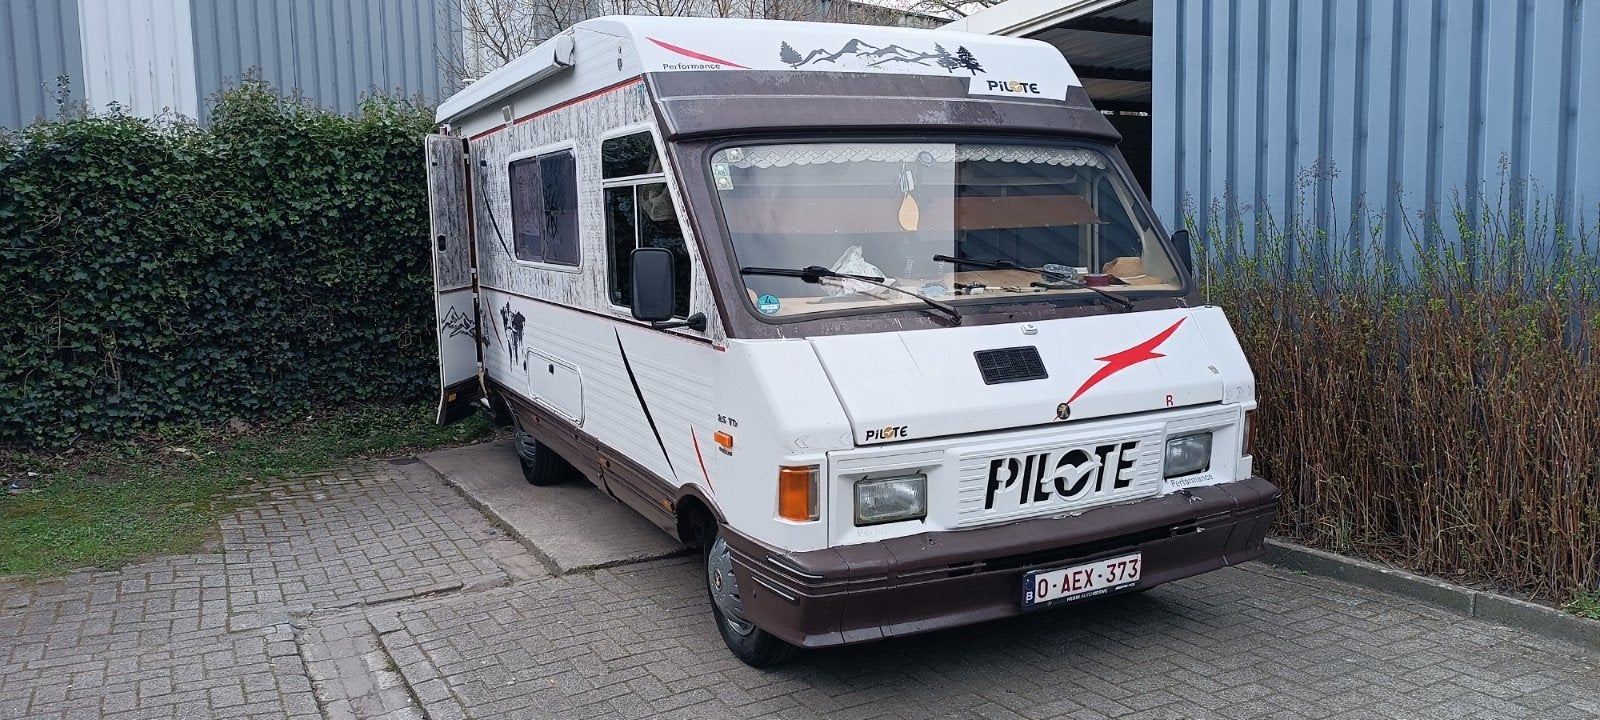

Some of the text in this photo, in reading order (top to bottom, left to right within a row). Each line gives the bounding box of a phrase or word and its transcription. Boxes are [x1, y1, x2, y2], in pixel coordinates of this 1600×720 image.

[662, 62, 721, 70] Performance
[1166, 394, 1174, 406] R
[984, 441, 1140, 511] PILOTE
[1170, 473, 1214, 487] Performance
[1025, 591, 1034, 601] B
